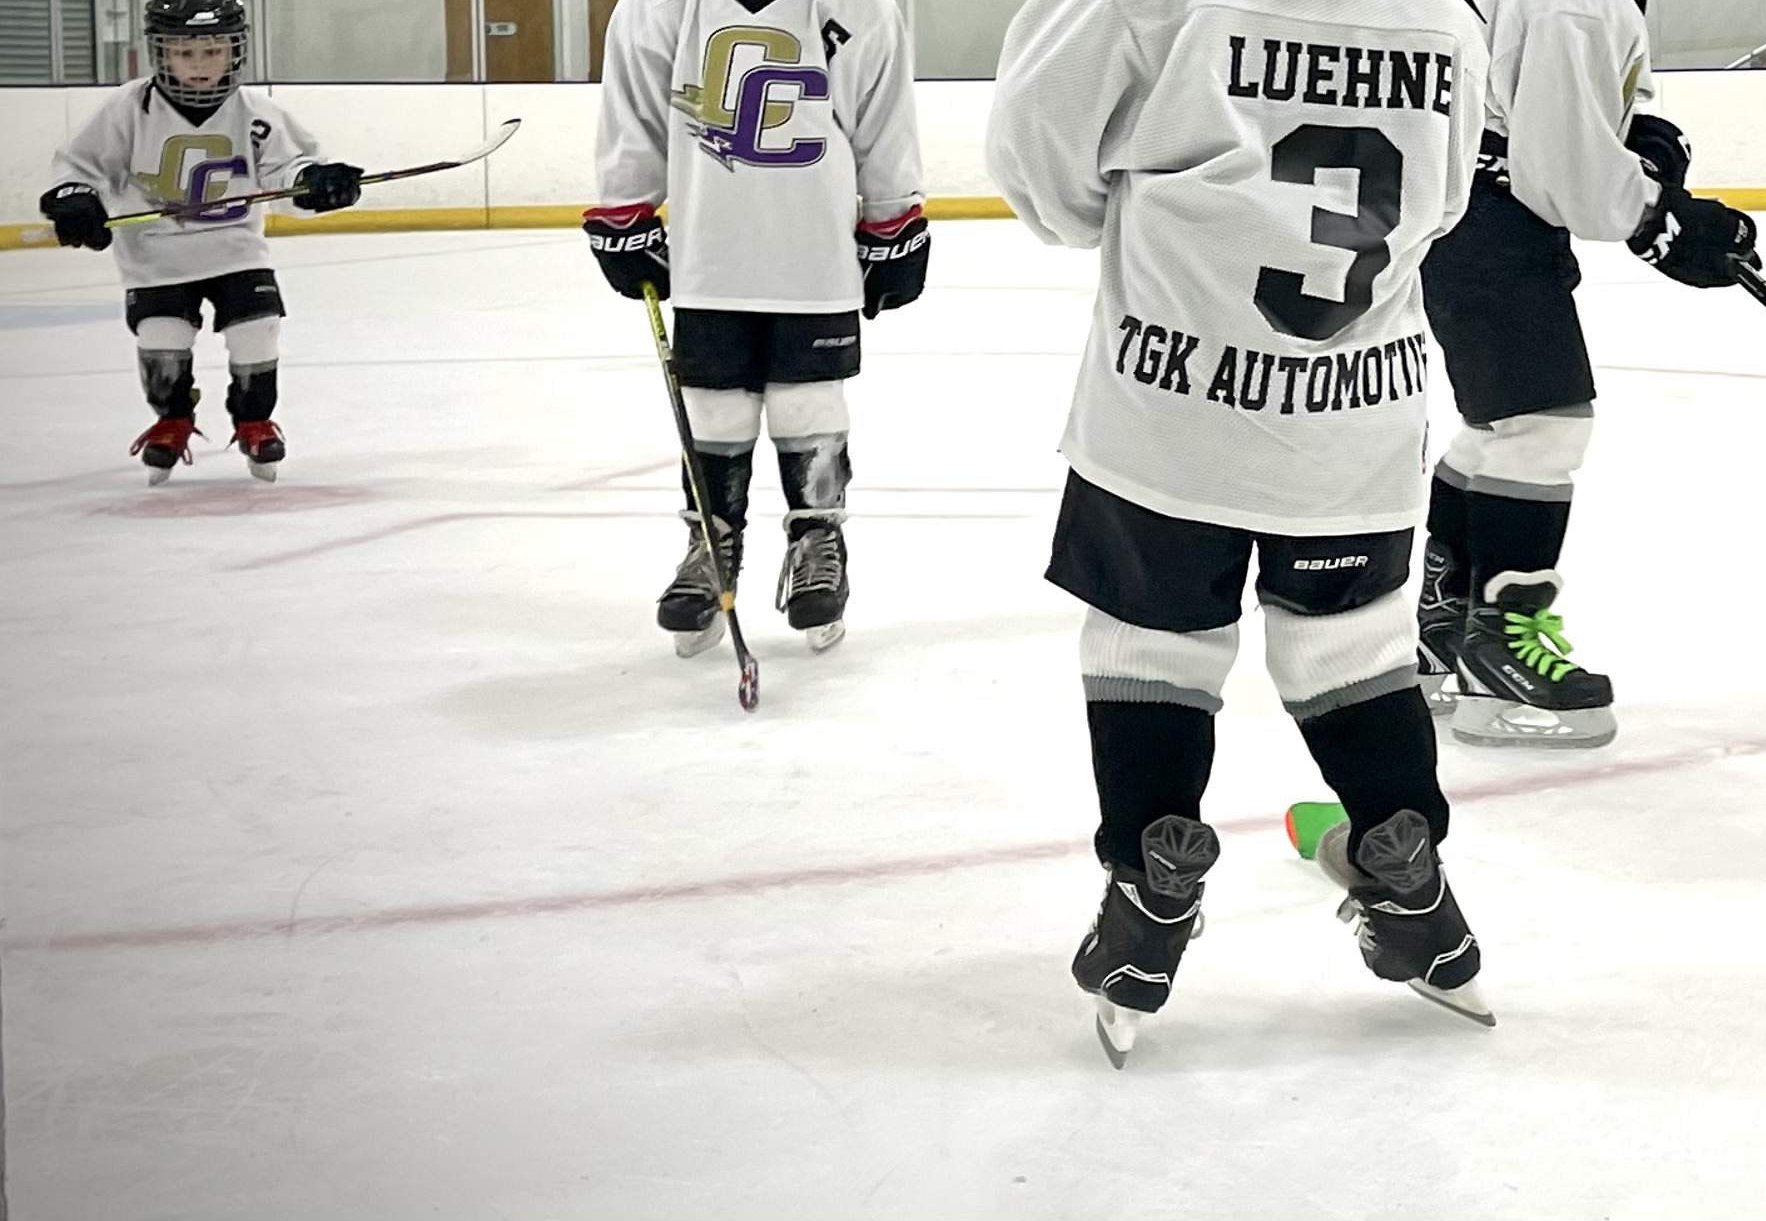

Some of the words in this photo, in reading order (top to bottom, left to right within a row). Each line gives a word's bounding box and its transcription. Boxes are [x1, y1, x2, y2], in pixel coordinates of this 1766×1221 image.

[1253, 123, 1404, 341] 3
[1116, 314, 1201, 395] TGK
[1294, 555, 1369, 570] BAUER
